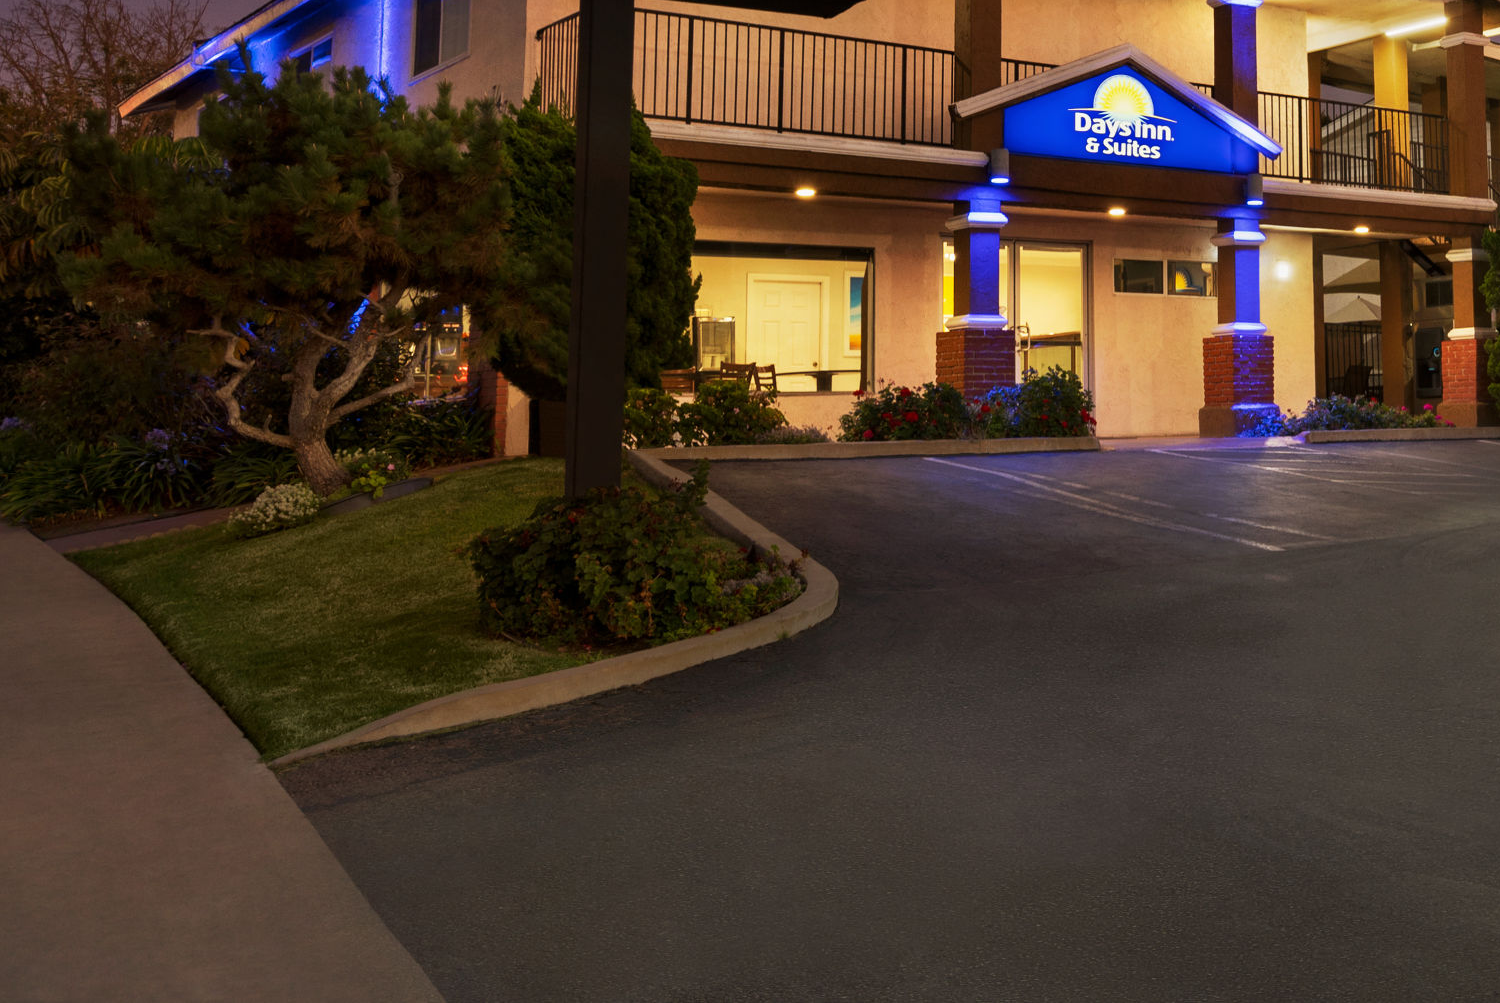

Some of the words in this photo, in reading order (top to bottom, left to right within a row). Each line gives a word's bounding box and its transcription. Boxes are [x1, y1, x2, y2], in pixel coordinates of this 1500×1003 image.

[1074, 112, 1132, 138] Days
[1085, 137, 1100, 153] &
[1102, 138, 1161, 159] Suites
